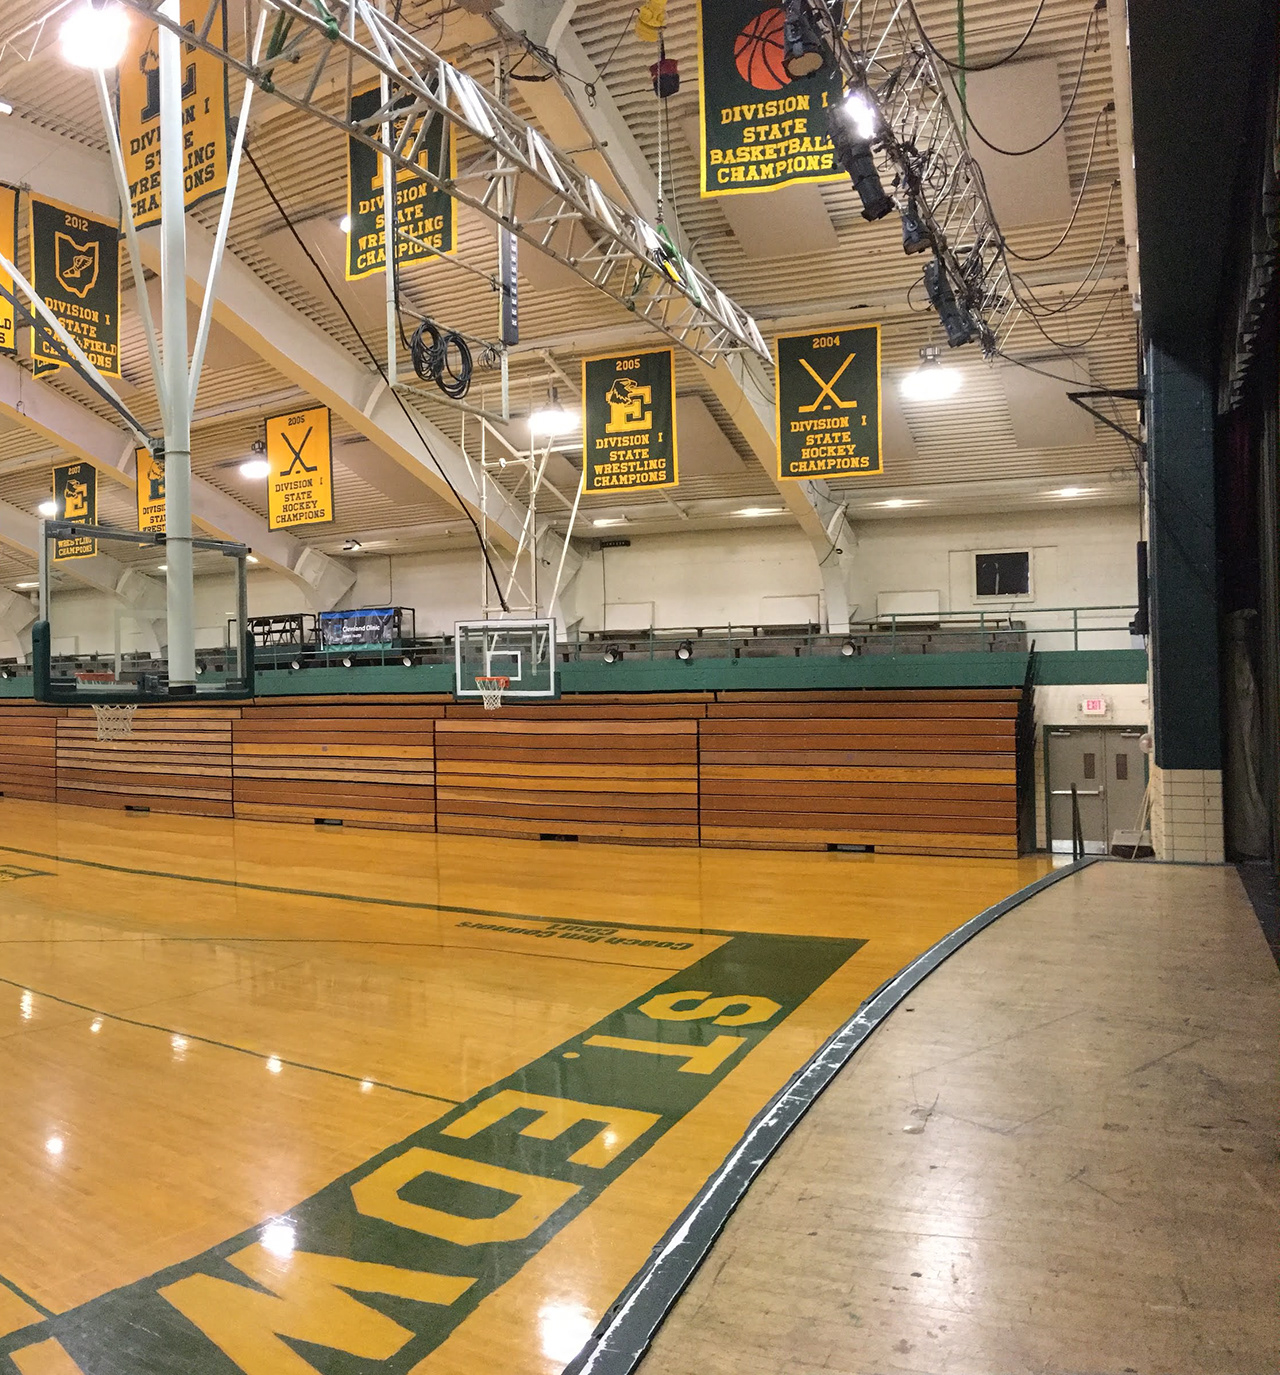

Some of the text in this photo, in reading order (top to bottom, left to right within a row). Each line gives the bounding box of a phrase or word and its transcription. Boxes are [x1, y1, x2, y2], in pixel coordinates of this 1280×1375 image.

[204, 97, 210, 114] I
[721, 92, 828, 124] DIVISION I
[743, 118, 807, 143] STATE
[710, 135, 834, 165] BASKETBALL
[717, 154, 834, 184] CHAMPIONS
[359, 183, 427, 214] DIVSION
[65, 215, 88, 232] 2012
[358, 216, 443, 251] WRETLING
[44, 296, 110, 326] DIVISION I
[58, 317, 96, 338] STATE
[813, 336, 840, 348] 2004
[616, 359, 640, 371] 2005
[287, 416, 305, 427] 2005
[790, 415, 866, 432] DIVISION I
[596, 432, 662, 449] DIVISION I
[806, 432, 851, 446] STATE
[610, 449, 649, 462] STATE
[802, 444, 857, 459] HOCKEY
[594, 458, 666, 474] WRESTLING
[790, 457, 869, 473] CHAMPIONS
[275, 480, 311, 492] DIVISION
[594, 470, 666, 486] CHAMPIONS
[284, 491, 312, 502] STATE
[282, 500, 318, 512] HOCKEY
[275, 509, 325, 523] CHAMPIONS
[611, 936, 694, 950] Coach
